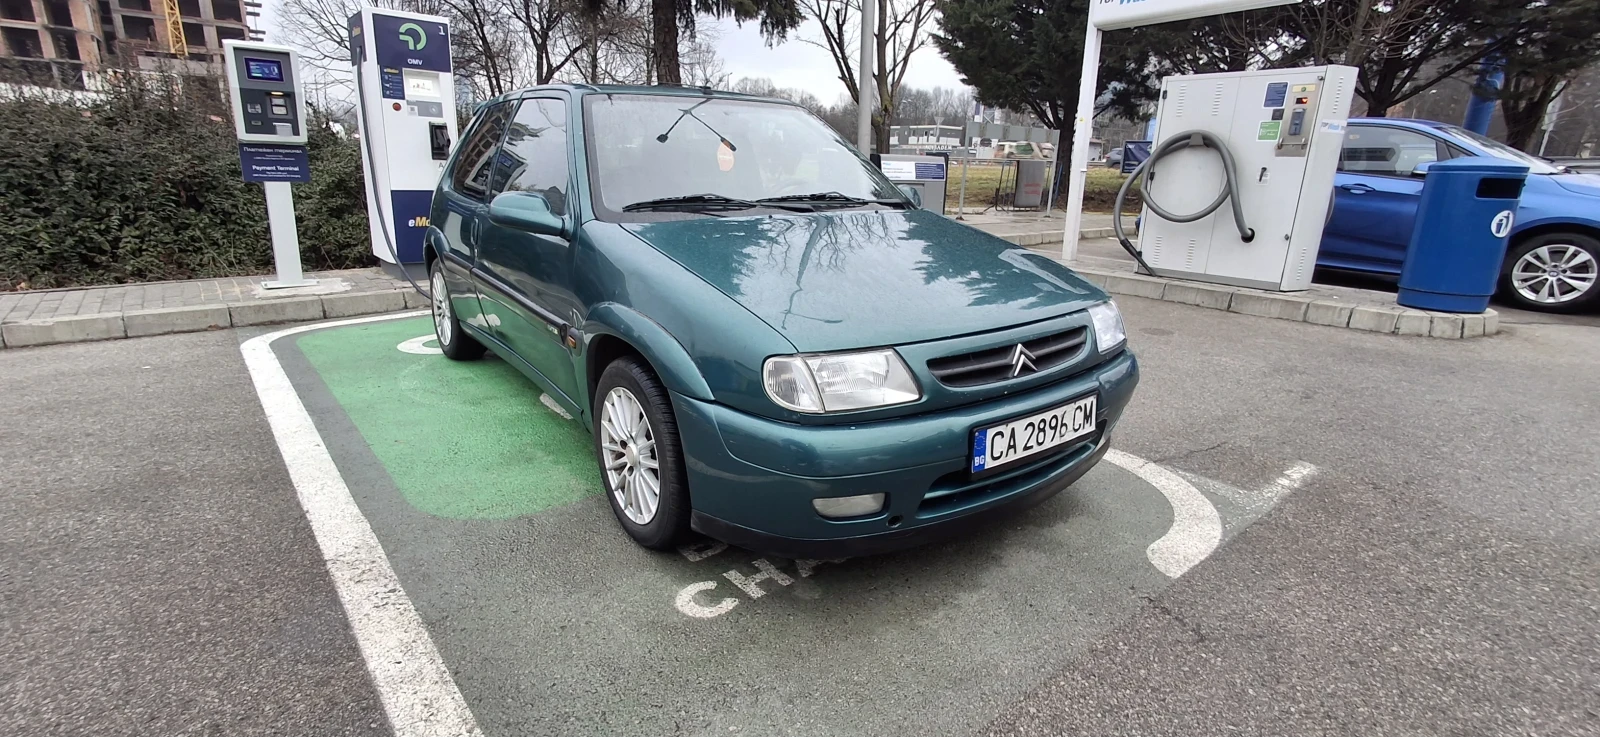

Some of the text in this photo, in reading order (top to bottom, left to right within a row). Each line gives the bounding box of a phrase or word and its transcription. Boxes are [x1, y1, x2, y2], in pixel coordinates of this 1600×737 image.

[438, 25, 446, 36] 1
[407, 58, 423, 66] OMV
[990, 400, 1094, 461] CA 2896 CM
[974, 455, 985, 467] BG
